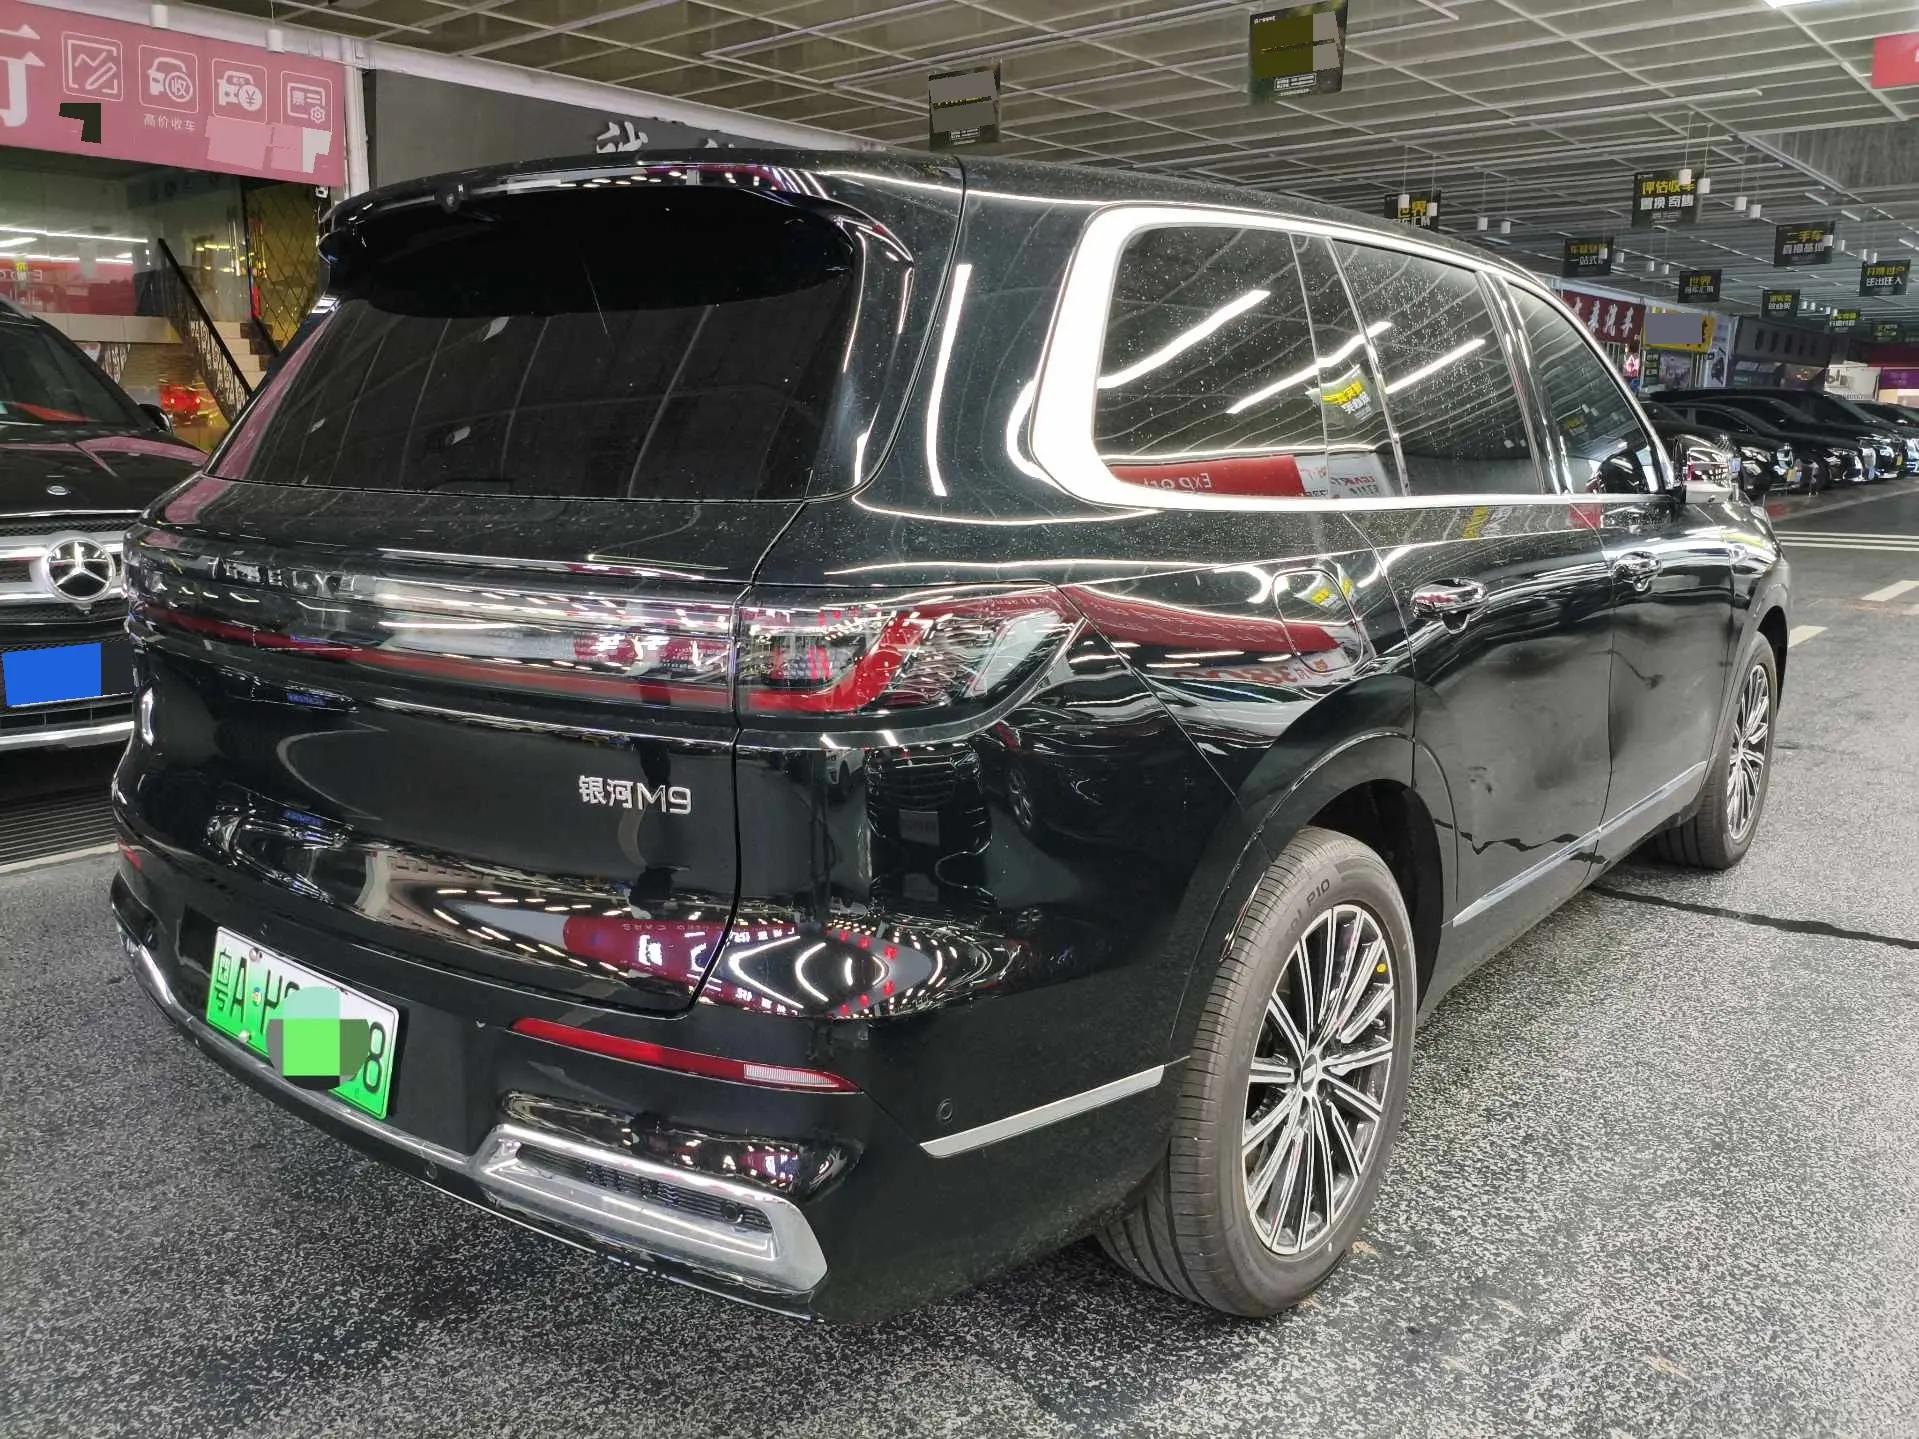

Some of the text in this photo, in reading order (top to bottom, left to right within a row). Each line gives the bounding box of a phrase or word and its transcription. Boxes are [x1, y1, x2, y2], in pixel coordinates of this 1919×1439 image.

[143, 113, 196, 131] 高价收车
[579, 775, 692, 815] 银河M9
